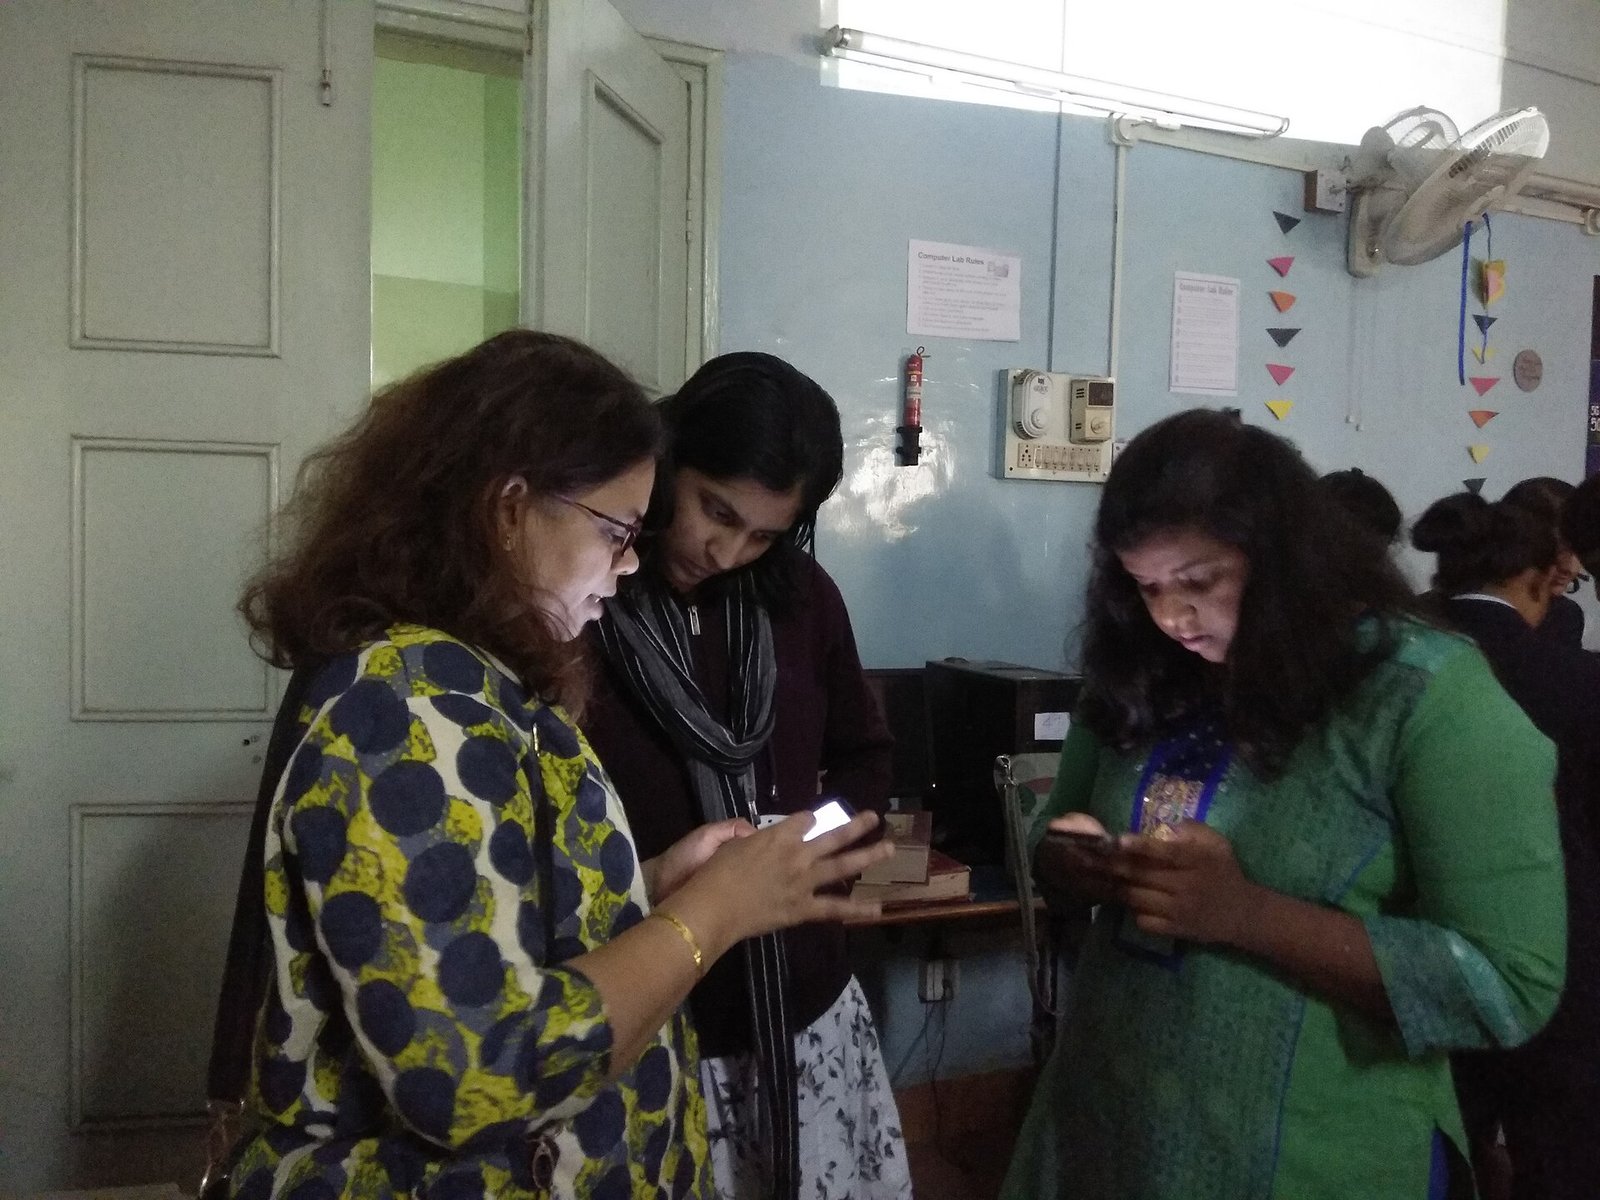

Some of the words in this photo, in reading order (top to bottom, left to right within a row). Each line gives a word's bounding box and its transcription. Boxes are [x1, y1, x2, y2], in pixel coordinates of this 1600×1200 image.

[918, 252, 950, 261] Computer
[952, 255, 965, 264] Lab
[966, 257, 985, 265] Rules
